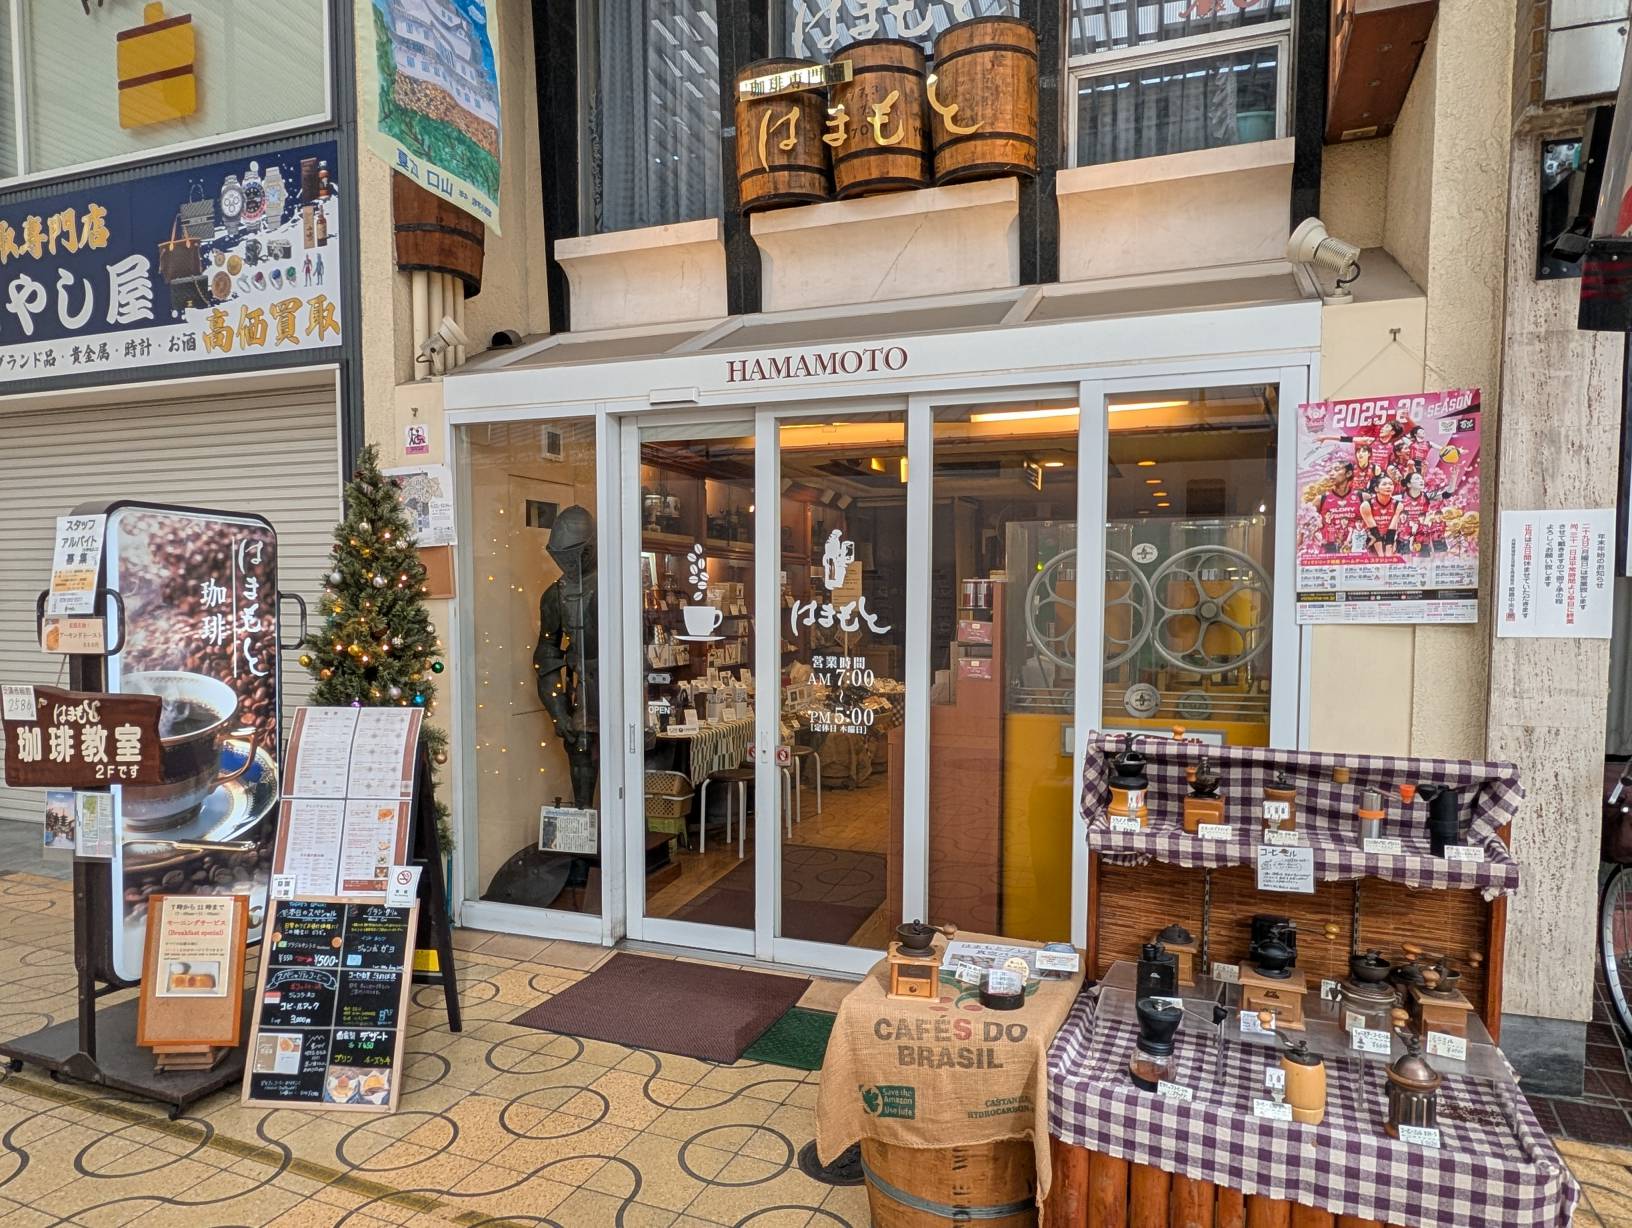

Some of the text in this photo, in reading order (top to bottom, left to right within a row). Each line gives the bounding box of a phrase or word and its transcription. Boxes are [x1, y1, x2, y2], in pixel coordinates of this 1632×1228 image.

[758, 74, 985, 172] はまもと
[0, 254, 154, 336] やし屋
[202, 294, 341, 354] 高価買取
[726, 346, 908, 383] HAMAMOTO
[1332, 397, 1425, 429] 2025-26
[1426, 393, 1473, 419] SEASON
[66, 520, 96, 532] スタッフ
[61, 535, 97, 548] アルバイト
[1596, 533, 1606, 589] 年末年始のお知らせ
[200, 578, 227, 646] 珈琲
[238, 539, 269, 677] はまもと
[790, 596, 892, 637] はまもと
[811, 655, 866, 670] 営業時間
[807, 669, 874, 687] AM 7:00
[53, 699, 102, 725] はまもと
[648, 704, 672, 715] OPEN
[810, 707, 874, 726] PM 5:00
[17, 723, 142, 763] 珈琲教室
[95, 764, 140, 779] 2Fです
[167, 919, 226, 927] モーニングサービス
[360, 1031, 389, 1042] デザート
[874, 1015, 1028, 1043] CAFÉS DO
[897, 1045, 1004, 1069] BRASIL
[884, 1096, 913, 1104] Amazon
